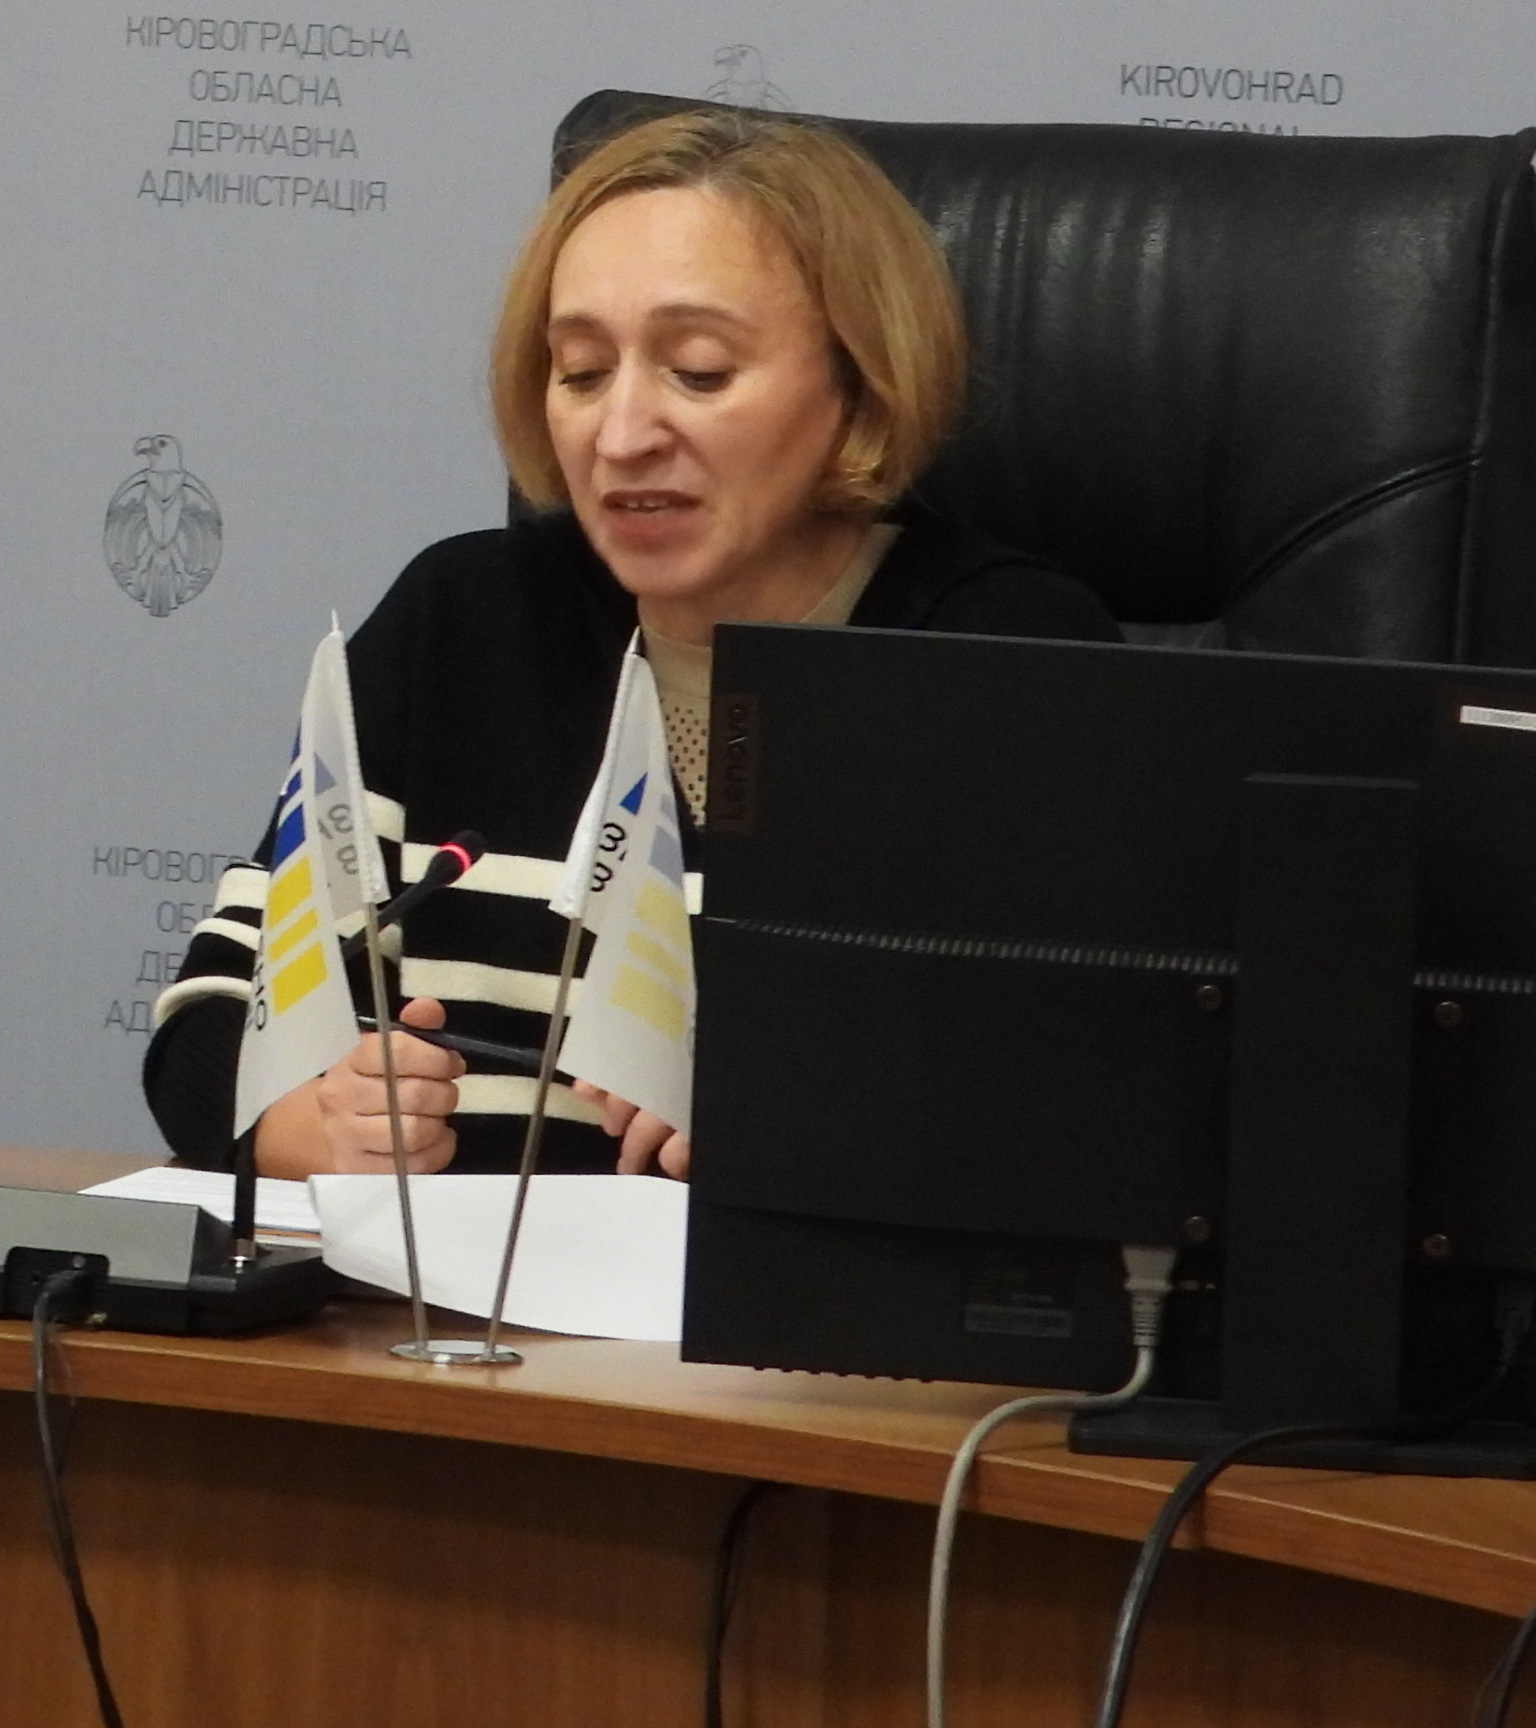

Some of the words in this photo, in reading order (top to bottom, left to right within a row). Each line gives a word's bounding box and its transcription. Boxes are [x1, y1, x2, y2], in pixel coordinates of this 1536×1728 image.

[127, 17, 412, 60] КІРОВОГРАДСЬКА
[190, 69, 342, 107] ОБЛАСНА
[1121, 64, 1343, 105] KIROVOHRAD
[168, 120, 357, 158] ДЕРЖАВНА
[137, 170, 386, 216] АДМІНІСТРАЦІЯ
